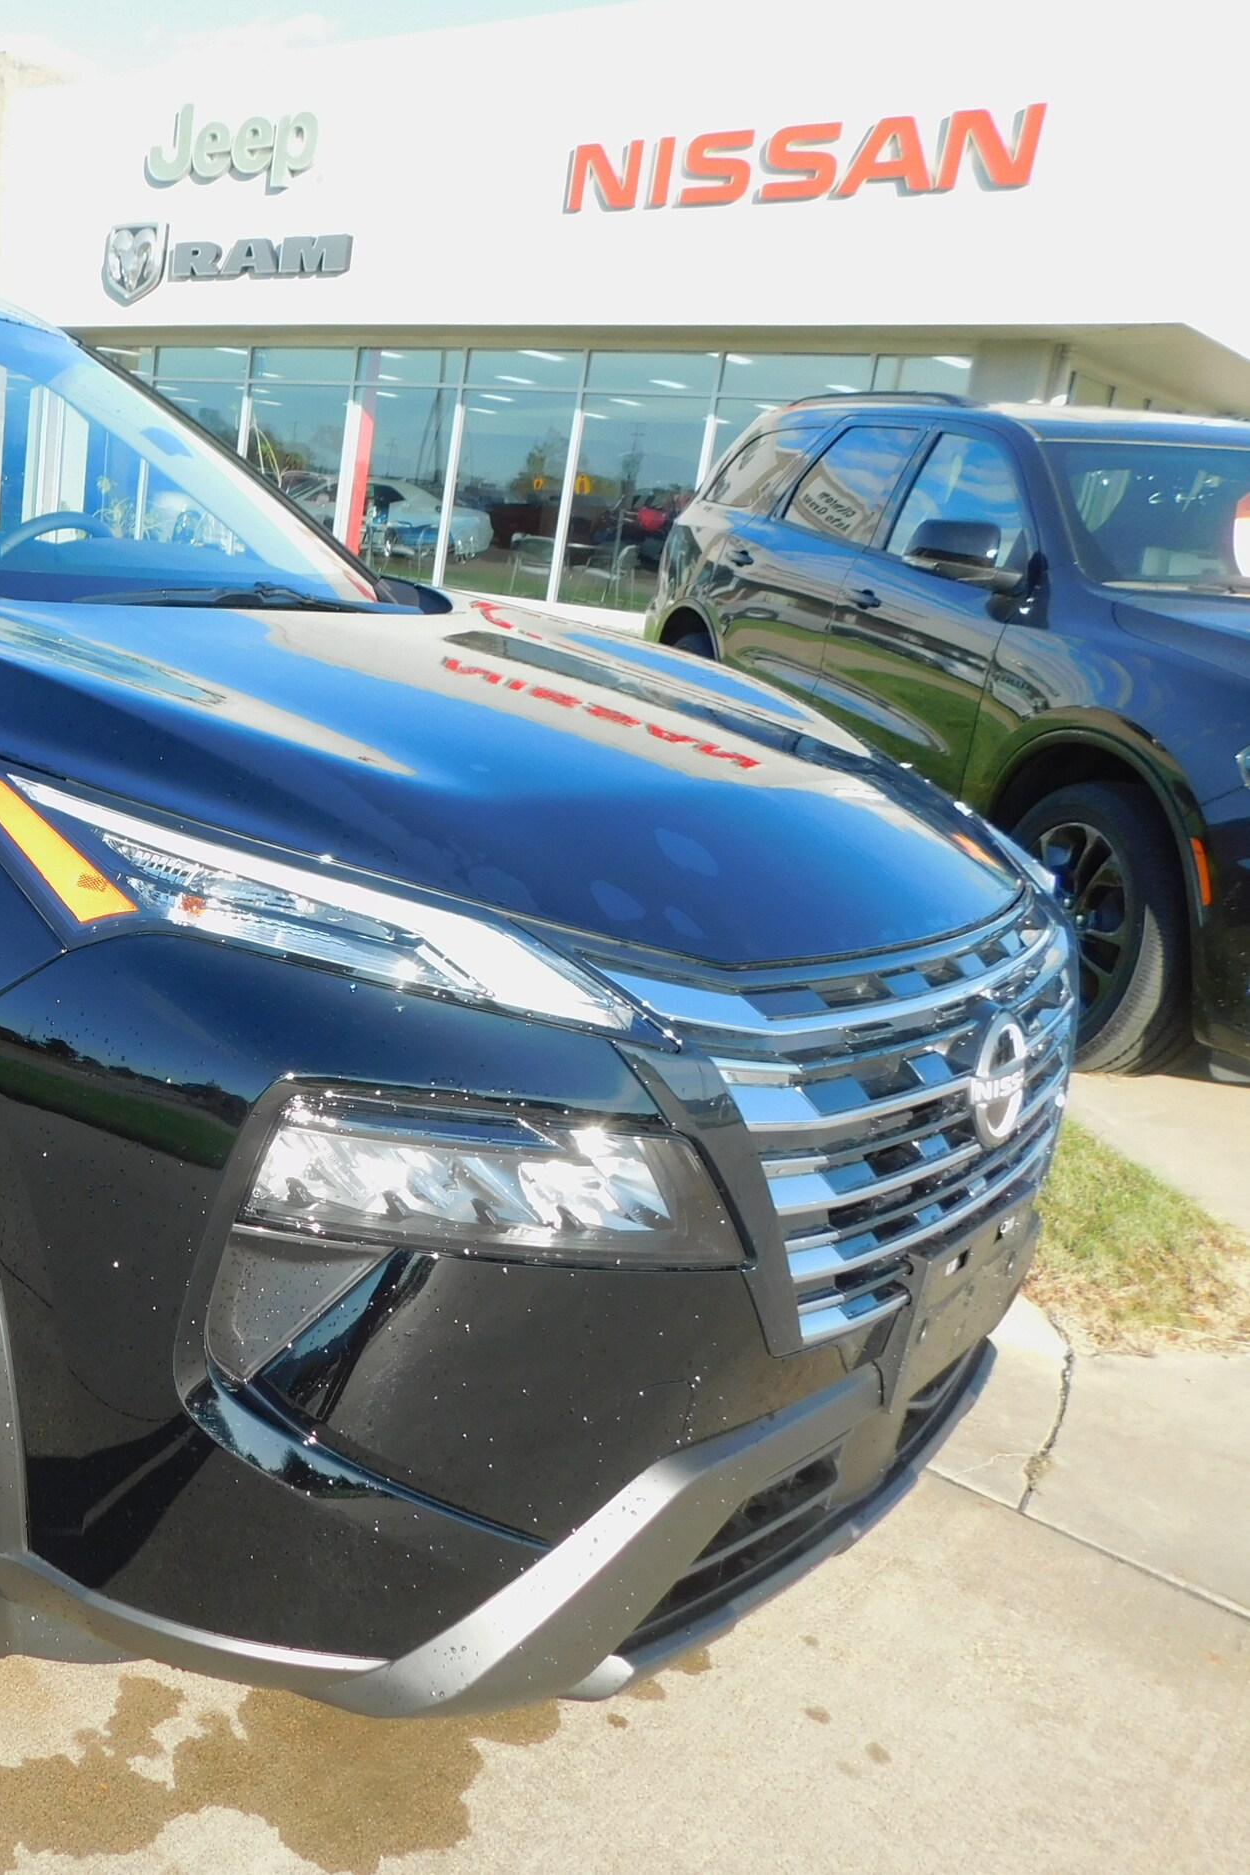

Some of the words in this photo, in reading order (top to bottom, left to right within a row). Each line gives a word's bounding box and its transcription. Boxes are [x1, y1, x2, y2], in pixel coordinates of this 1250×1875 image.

[145, 103, 319, 195] Jeep
[562, 102, 1048, 214] NISSAN
[168, 234, 354, 283] RAM
[973, 1069, 1024, 1101] NISS
